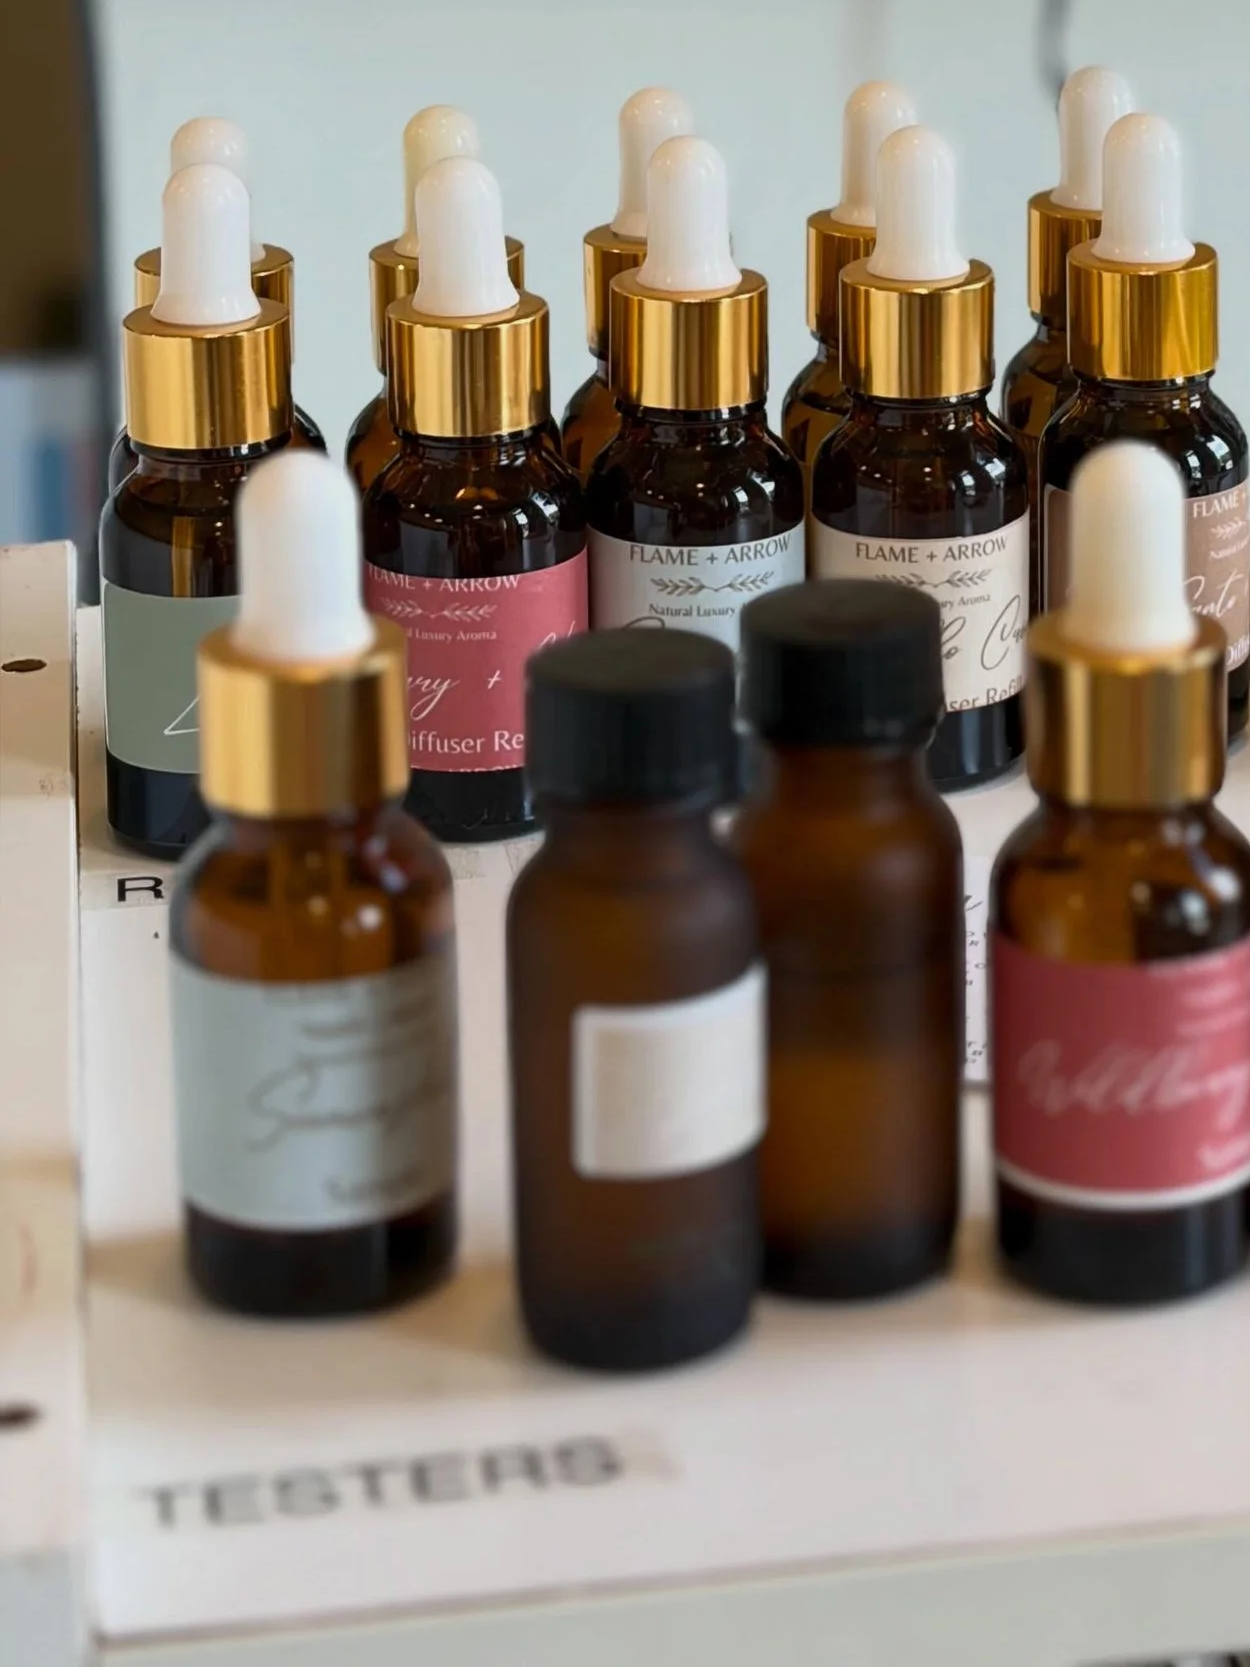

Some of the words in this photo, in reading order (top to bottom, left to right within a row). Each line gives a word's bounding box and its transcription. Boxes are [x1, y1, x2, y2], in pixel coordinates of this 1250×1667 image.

[1192, 492, 1239, 518] FLAME
[630, 544, 699, 566] FLAME
[706, 553, 718, 565] +
[725, 533, 791, 564] ARROW
[856, 542, 919, 563] FLAME
[926, 550, 938, 562] +
[942, 536, 1007, 562] ARROW
[422, 580, 432, 590] +
[439, 575, 521, 592] ARROW
[649, 603, 693, 617] Natural
[697, 605, 736, 618] Luxury
[957, 594, 991, 608] Aroma
[416, 629, 452, 643] Luxury
[456, 630, 497, 640] Aroma
[409, 731, 486, 754] iffuser
[136, 1435, 622, 1529] TESTERS
